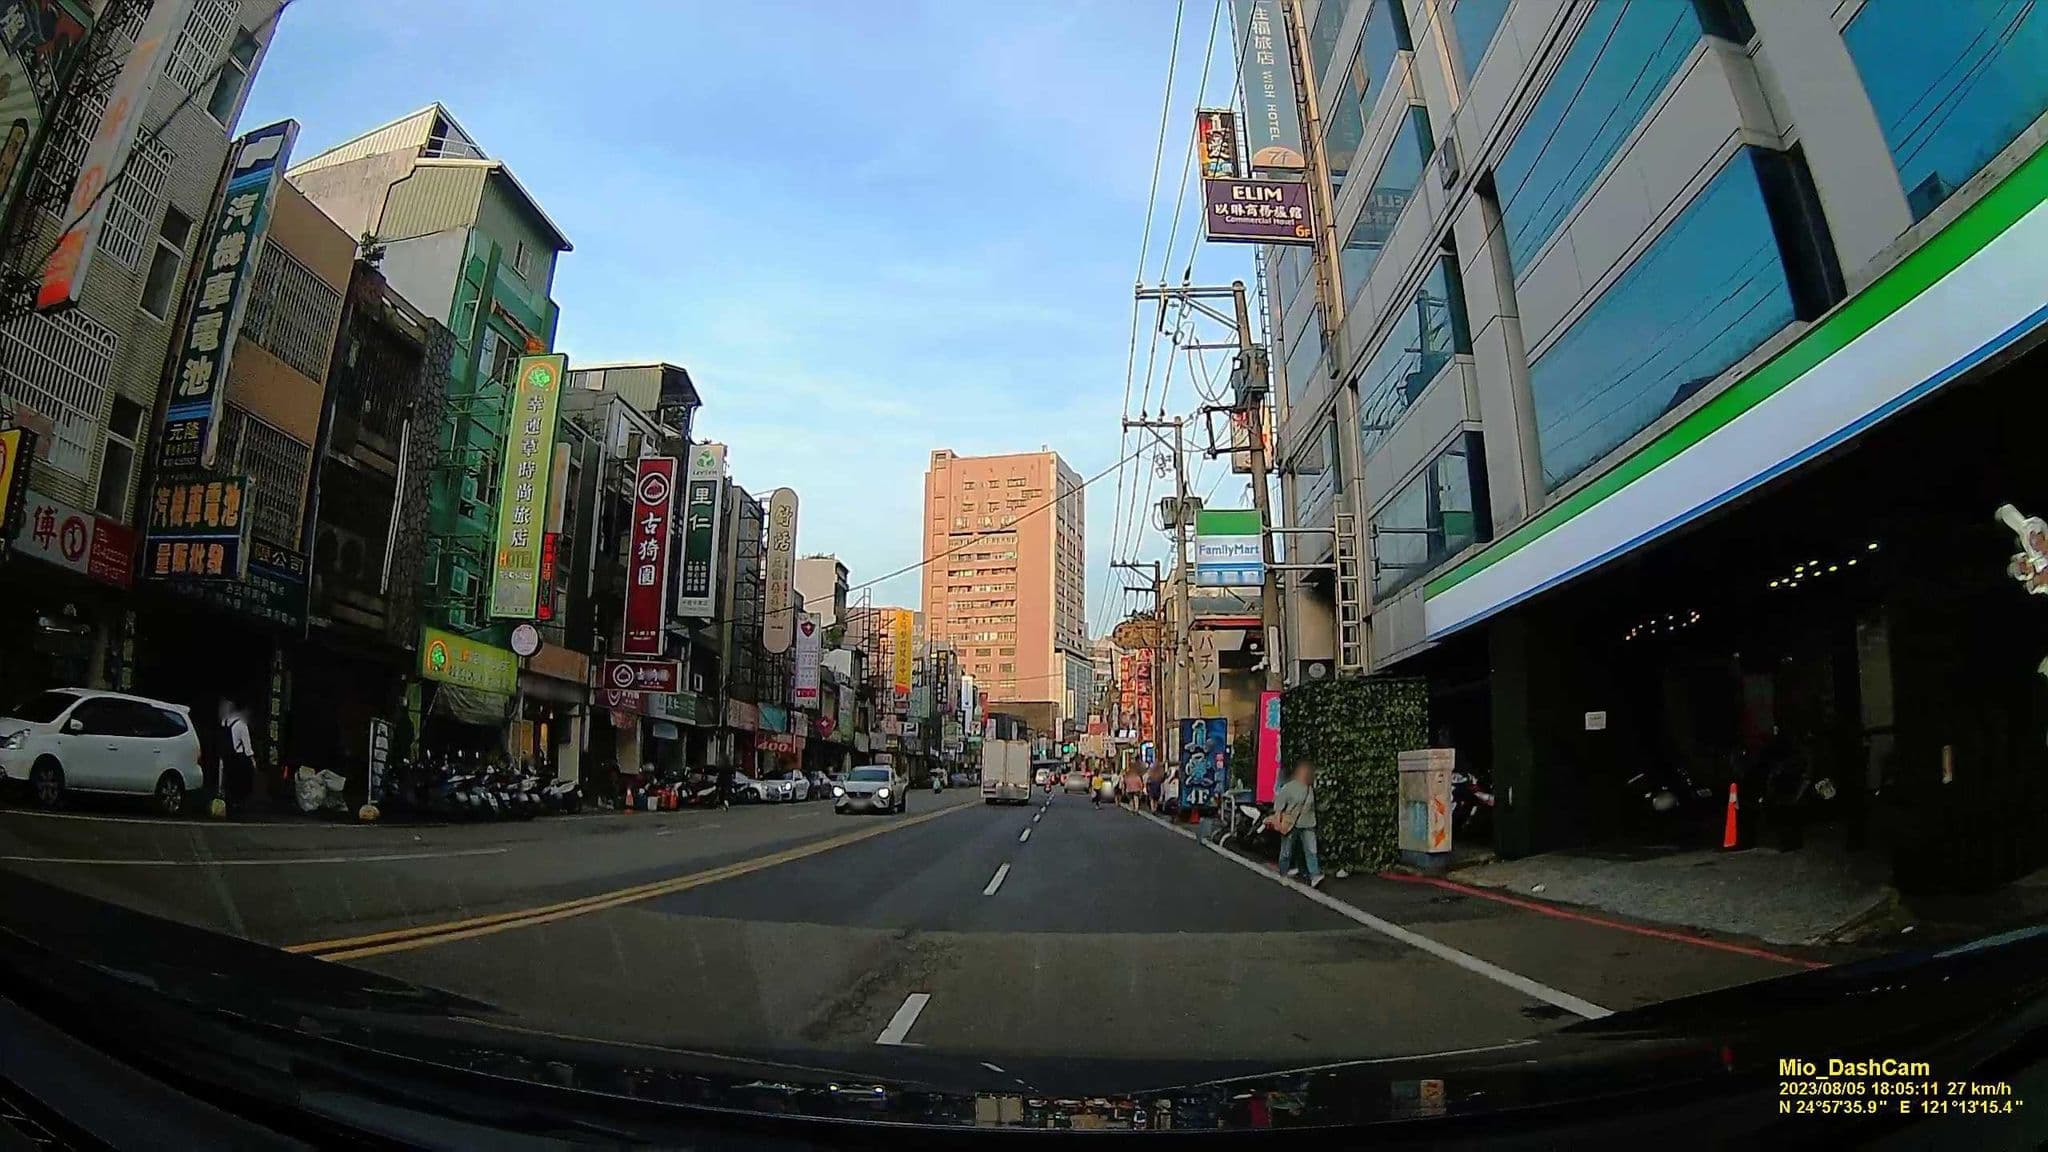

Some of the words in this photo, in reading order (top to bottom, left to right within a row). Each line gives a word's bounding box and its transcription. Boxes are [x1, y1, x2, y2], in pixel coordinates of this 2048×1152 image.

[1262, 70, 1276, 99] WISH
[1267, 104, 1281, 141] HOTEL
[1232, 185, 1283, 201] ELIM
[1225, 215, 1272, 225] Commercial
[1295, 224, 1311, 237] 6F
[510, 395, 545, 548] 幸運草時尚旅店
[689, 487, 714, 531] 里仁
[1199, 543, 1260, 559] FamilyMart
